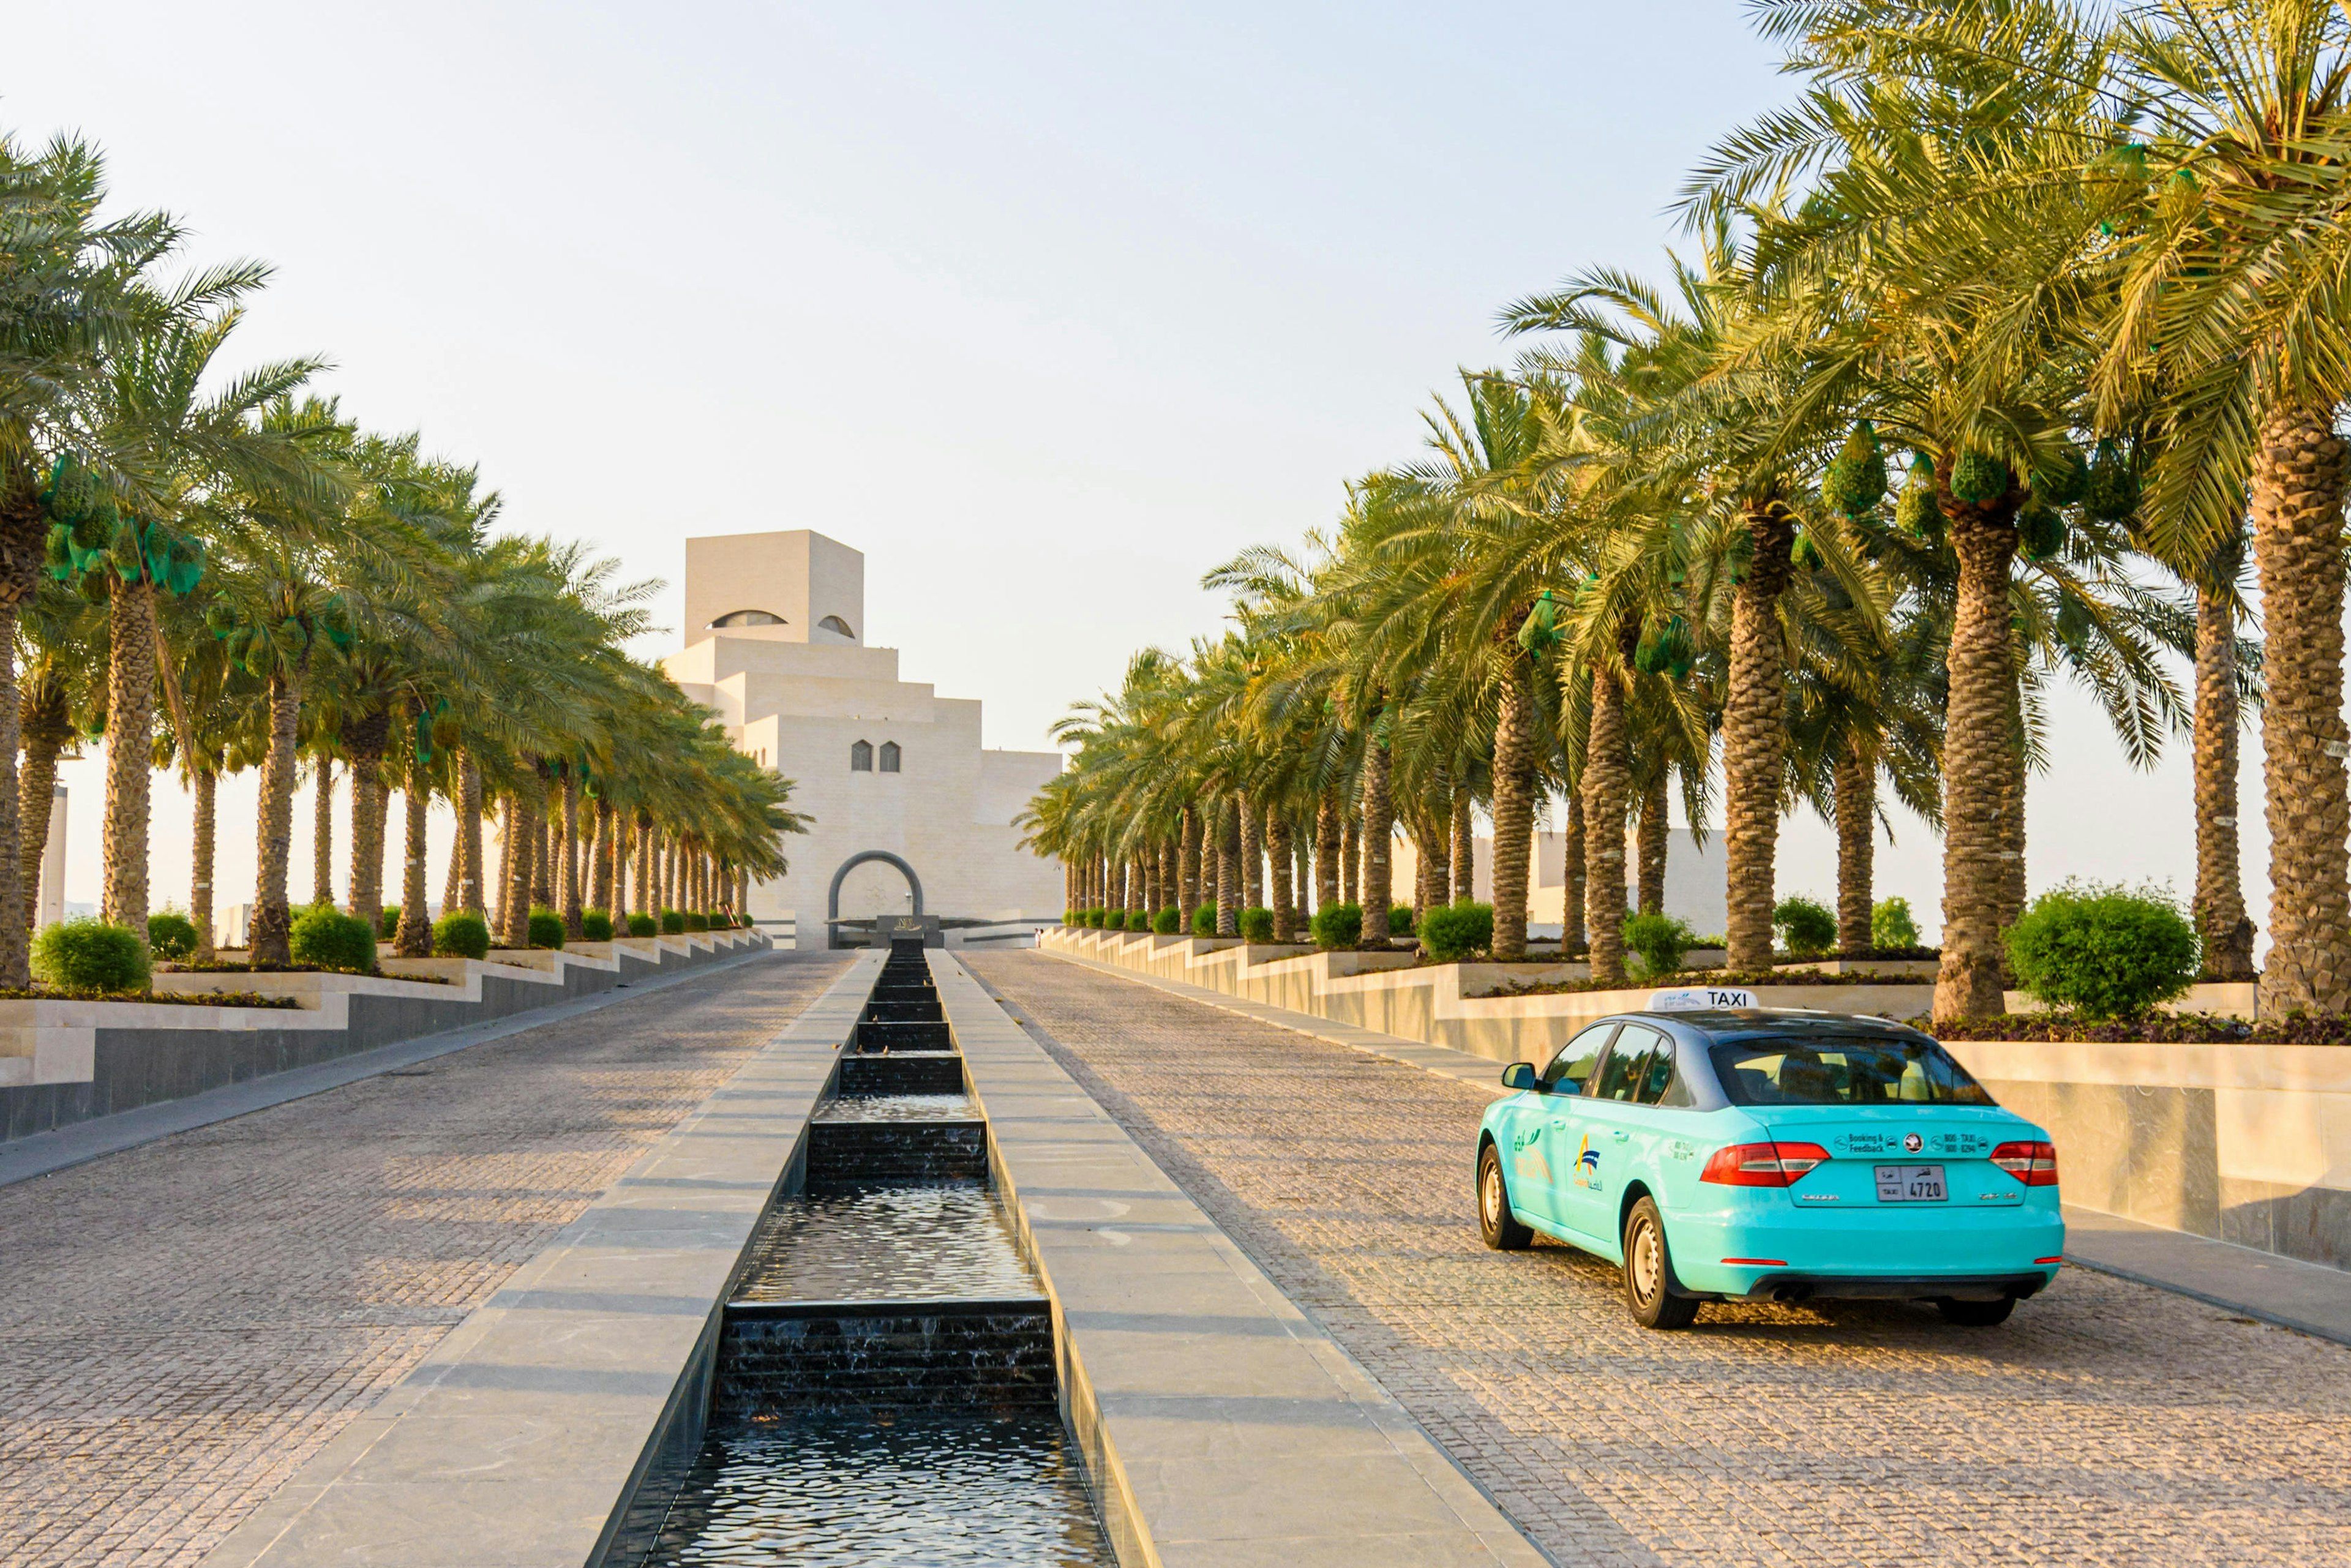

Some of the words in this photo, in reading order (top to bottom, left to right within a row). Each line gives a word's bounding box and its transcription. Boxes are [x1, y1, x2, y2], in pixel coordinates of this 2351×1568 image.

[1708, 992, 1746, 1007] TAXI
[1849, 1133, 1877, 1144] Booking
[1850, 1144, 1883, 1152] Feedback
[1910, 1182, 1941, 1197] 4720
